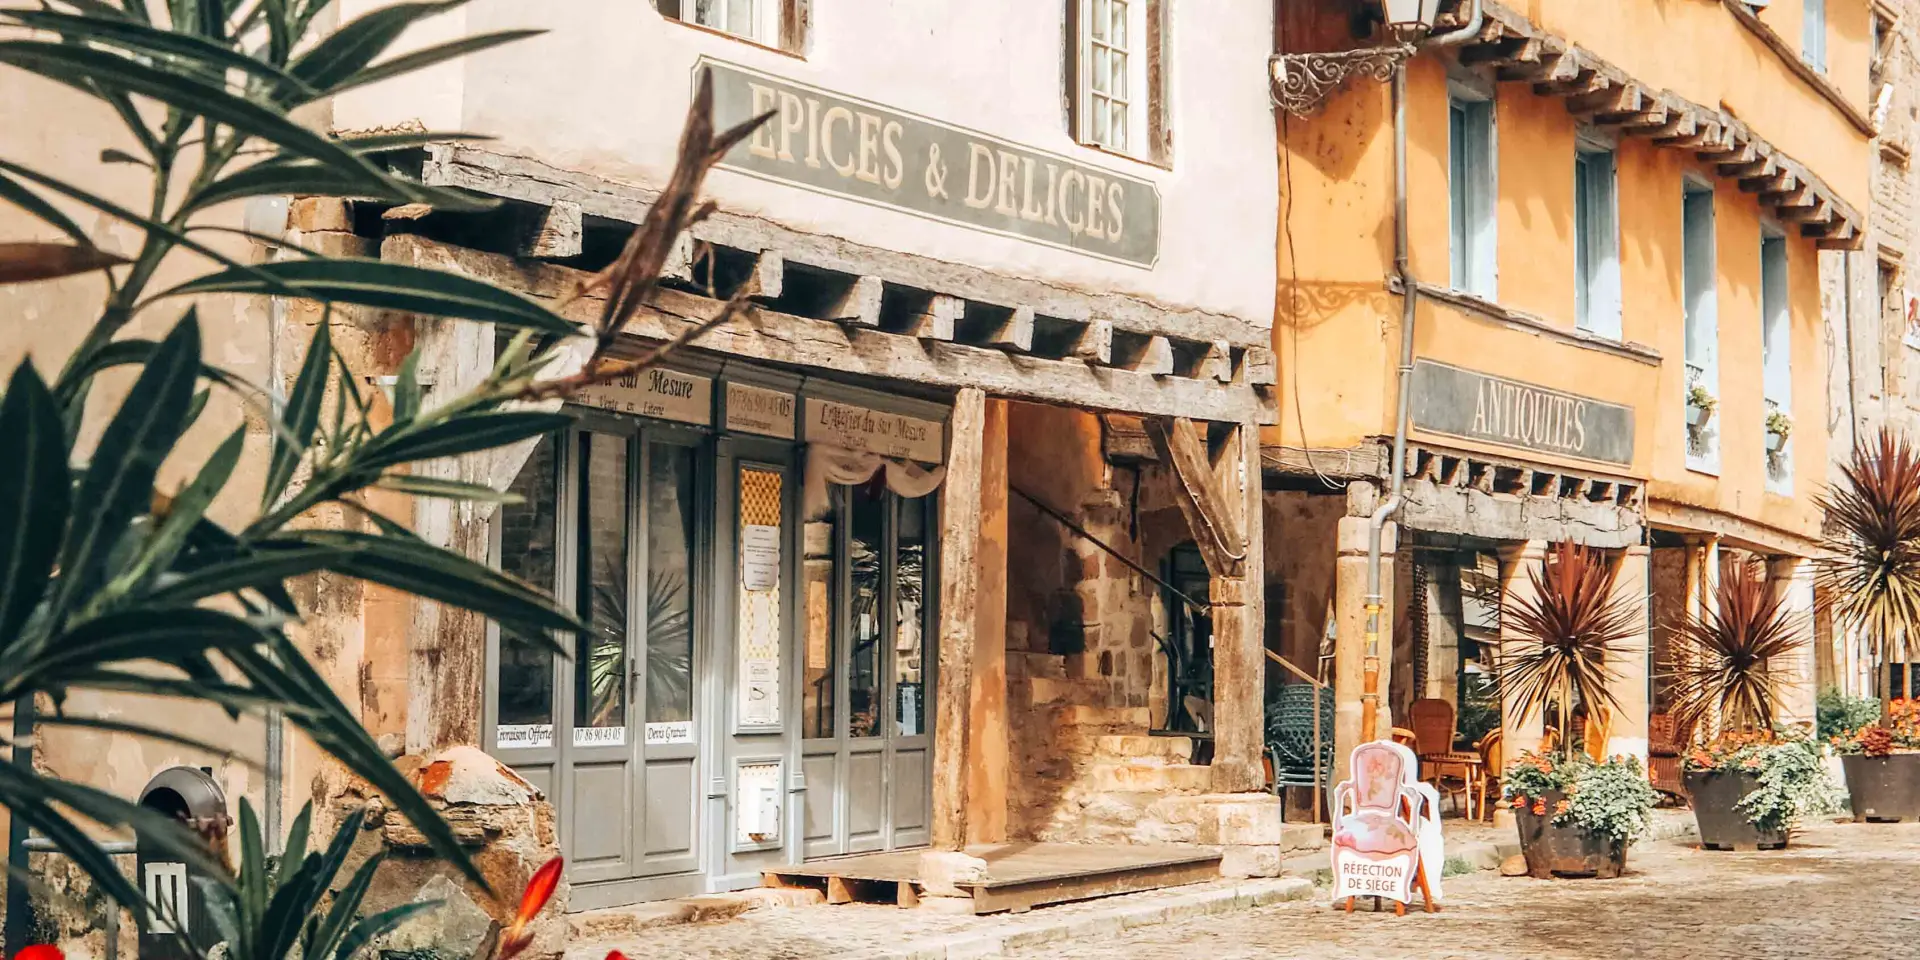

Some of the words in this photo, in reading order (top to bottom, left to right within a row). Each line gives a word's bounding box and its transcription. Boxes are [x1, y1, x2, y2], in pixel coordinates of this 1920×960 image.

[748, 82, 904, 190] EPICES
[925, 142, 949, 200] &
[964, 142, 1124, 244] DELICES
[648, 369, 693, 399] Mesure
[1472, 379, 1586, 452] ANTIQUITES
[895, 418, 927, 441] Mesure
[528, 726, 552, 745] Offerte
[574, 727, 584, 742] 07
[584, 728, 593, 742] 86
[594, 728, 603, 741] 90
[604, 727, 612, 741] 43
[613, 727, 621, 740] 05
[647, 725, 665, 740] Devis
[1344, 861, 1402, 878] RÉFECTION
[1348, 877, 1362, 889] DE
[1366, 877, 1397, 892] SIÈGE
